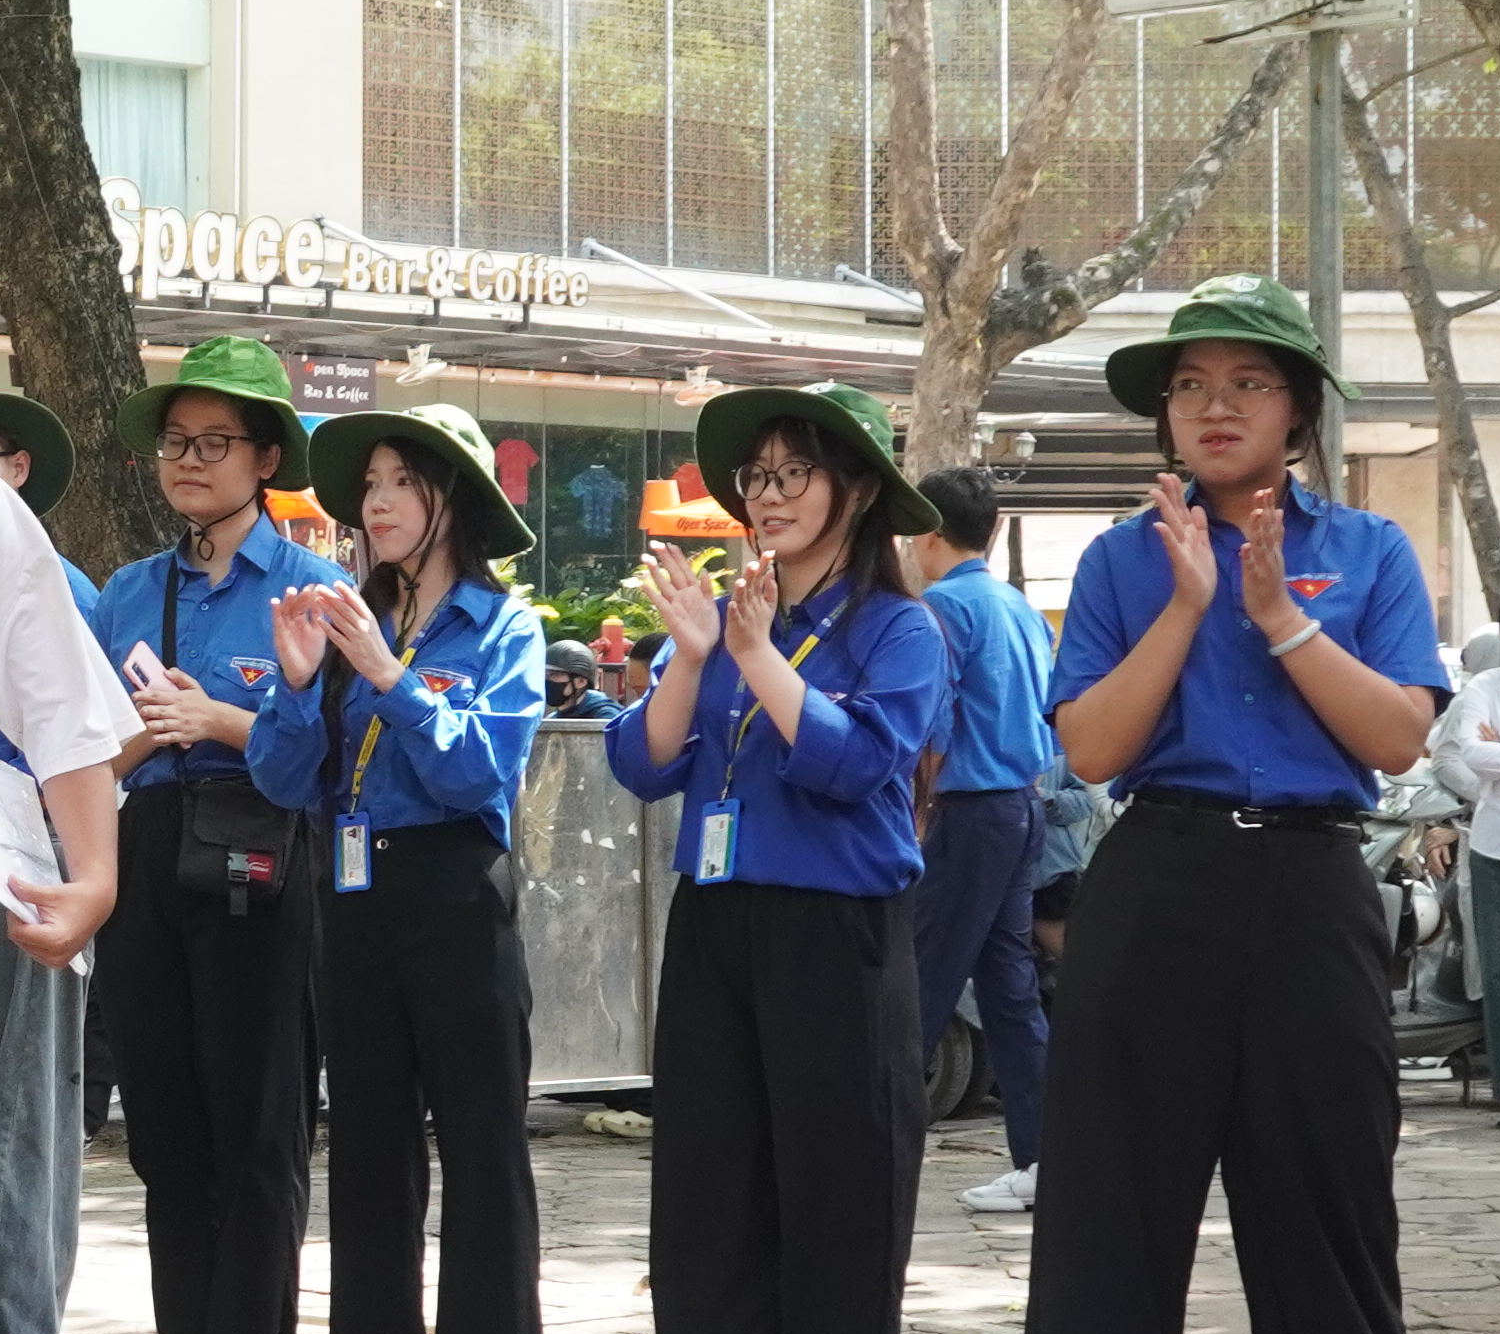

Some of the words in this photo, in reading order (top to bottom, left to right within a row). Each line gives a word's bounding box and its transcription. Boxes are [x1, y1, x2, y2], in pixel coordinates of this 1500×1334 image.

[100, 175, 326, 300] Space
[344, 240, 418, 295] Bar
[425, 246, 457, 299] &
[463, 249, 590, 308] Coffee
[336, 362, 370, 379] Space
